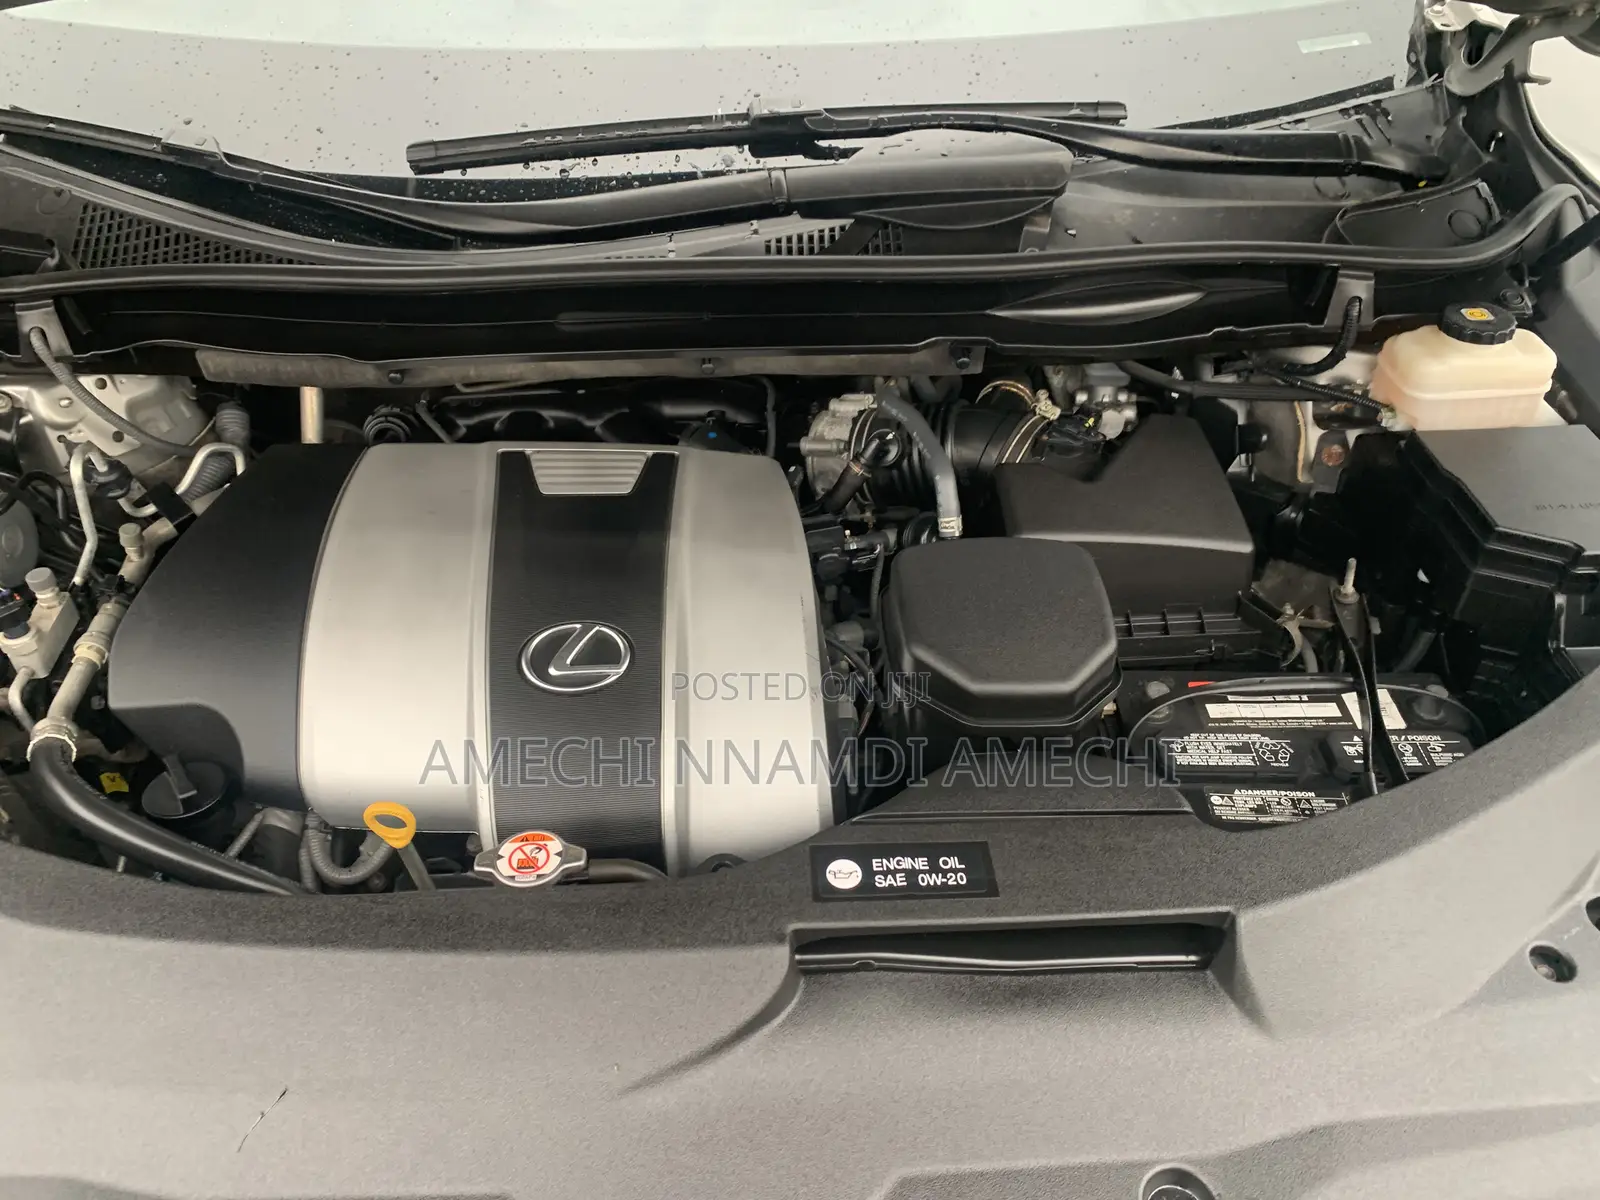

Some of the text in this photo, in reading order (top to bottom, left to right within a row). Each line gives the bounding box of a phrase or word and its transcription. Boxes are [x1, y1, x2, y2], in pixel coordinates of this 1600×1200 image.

[872, 856, 965, 871] ENGINE OIL
[874, 872, 967, 888] SAE 0W-20
